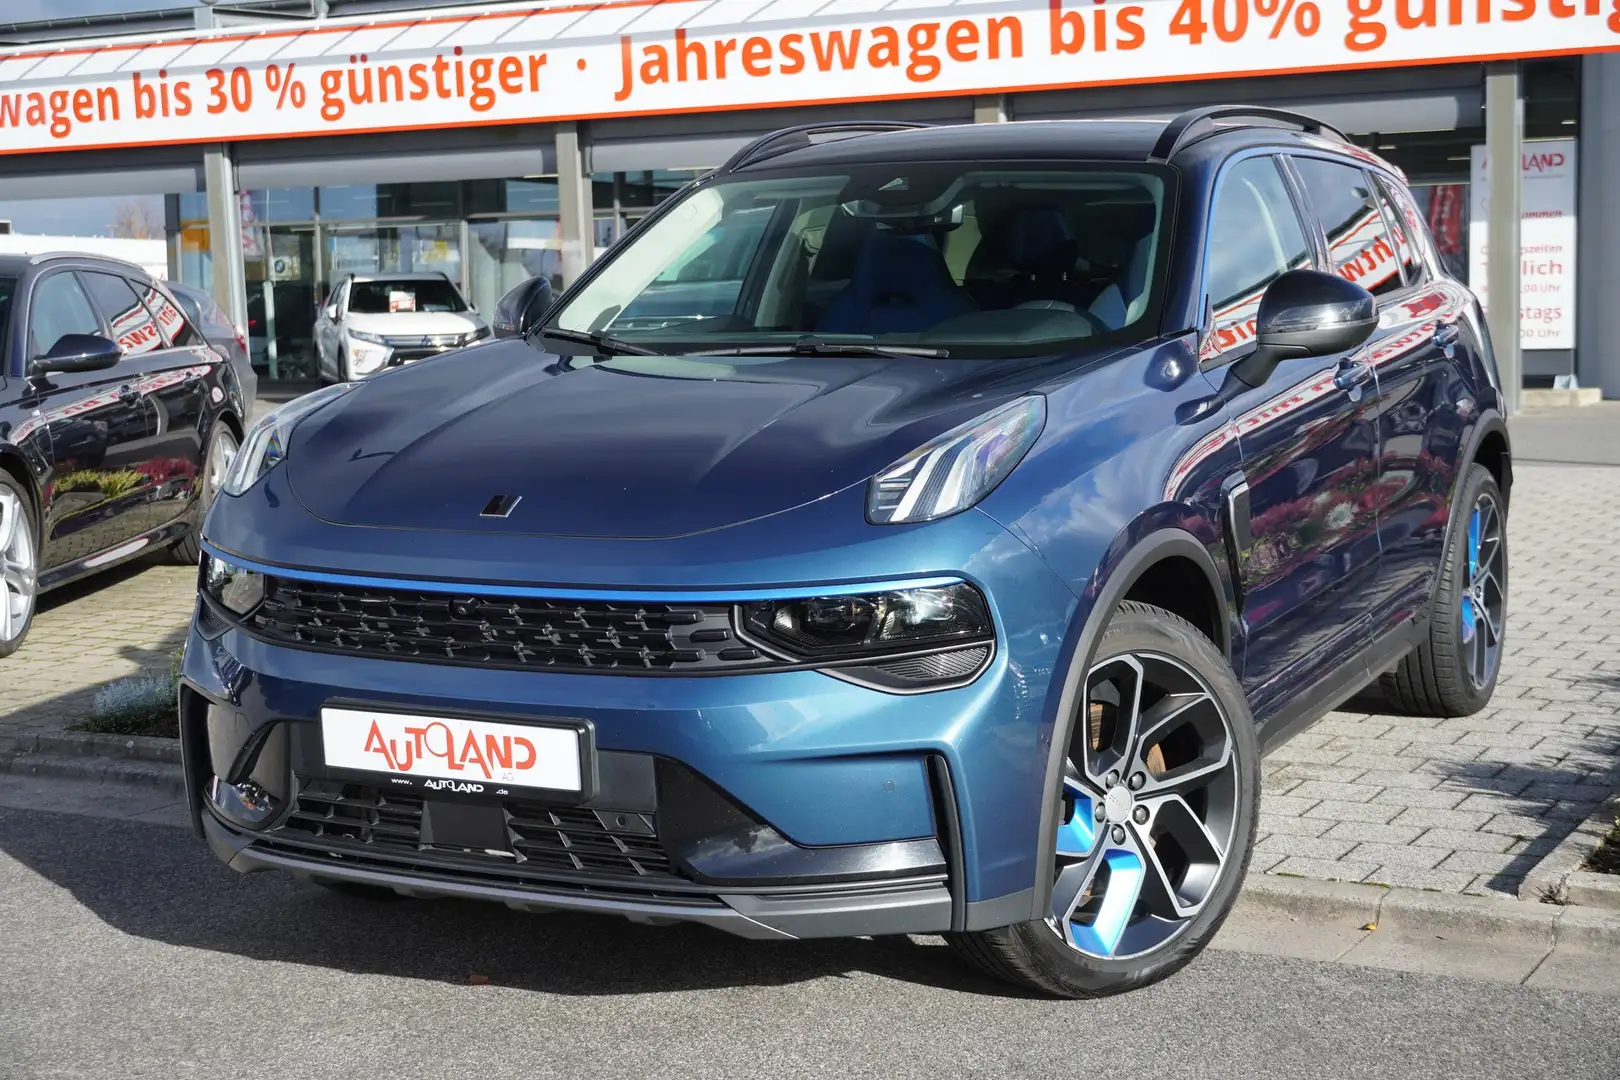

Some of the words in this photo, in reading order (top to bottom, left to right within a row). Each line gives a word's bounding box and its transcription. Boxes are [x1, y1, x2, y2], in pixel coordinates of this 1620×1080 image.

[132, 69, 193, 120] bis
[205, 66, 253, 115] 30
[265, 63, 306, 110] %
[320, 46, 548, 122] günstiger
[614, 14, 1024, 101] Jahreswagen
[1049, 0, 1146, 56] bis
[364, 719, 537, 779] AUTOLAND
[391, 778, 413, 786] www.
